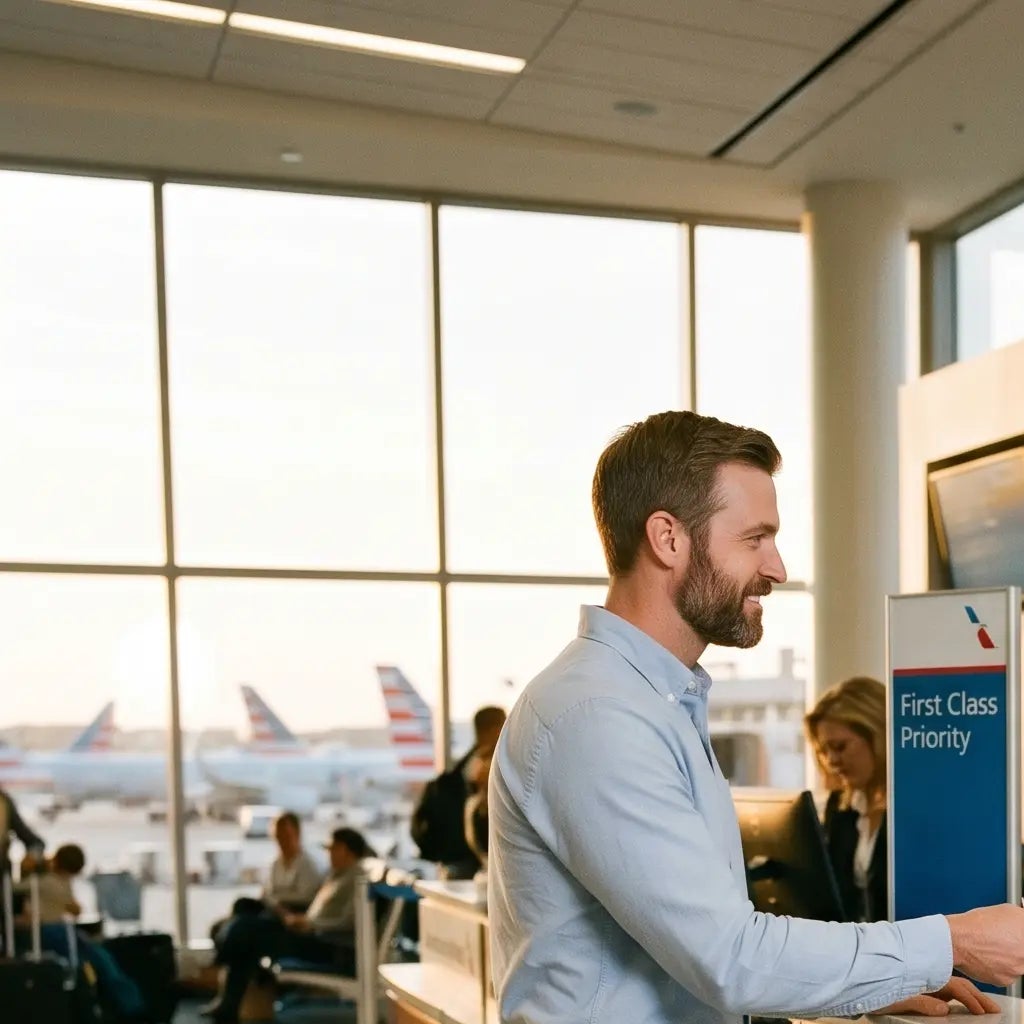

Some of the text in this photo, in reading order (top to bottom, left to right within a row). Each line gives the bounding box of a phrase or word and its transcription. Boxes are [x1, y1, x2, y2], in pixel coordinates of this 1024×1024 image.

[901, 690, 998, 716] First Class
[901, 724, 971, 756] Priority
